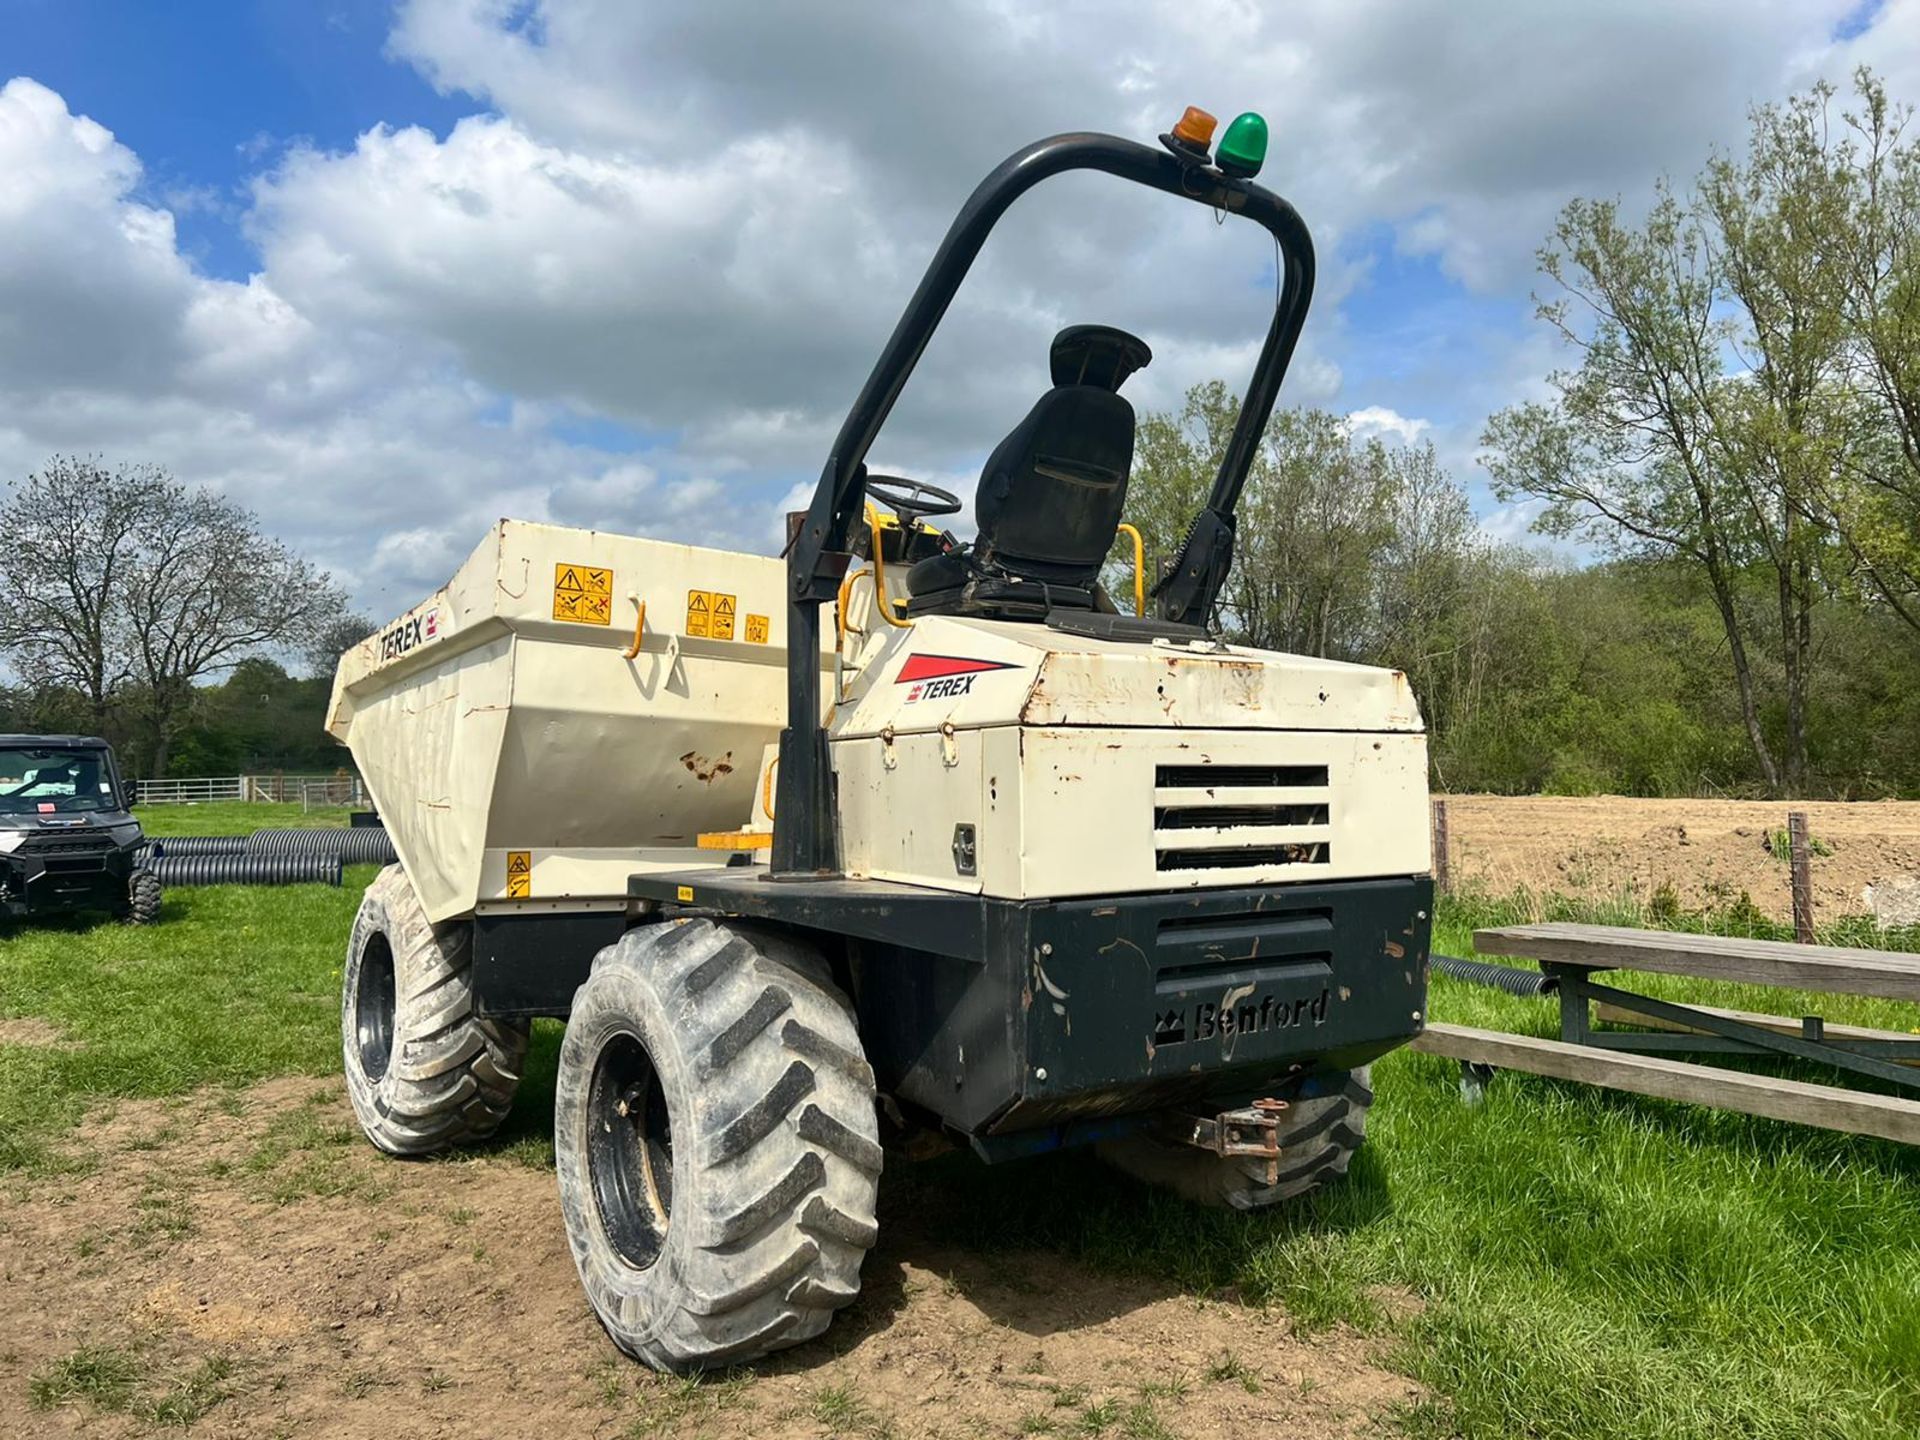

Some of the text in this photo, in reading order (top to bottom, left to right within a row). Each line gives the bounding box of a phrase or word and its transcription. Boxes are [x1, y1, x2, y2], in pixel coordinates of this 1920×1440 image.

[381, 614, 423, 662] TEREX
[922, 674, 977, 700] TEREX
[1193, 989, 1329, 1042] Benford
